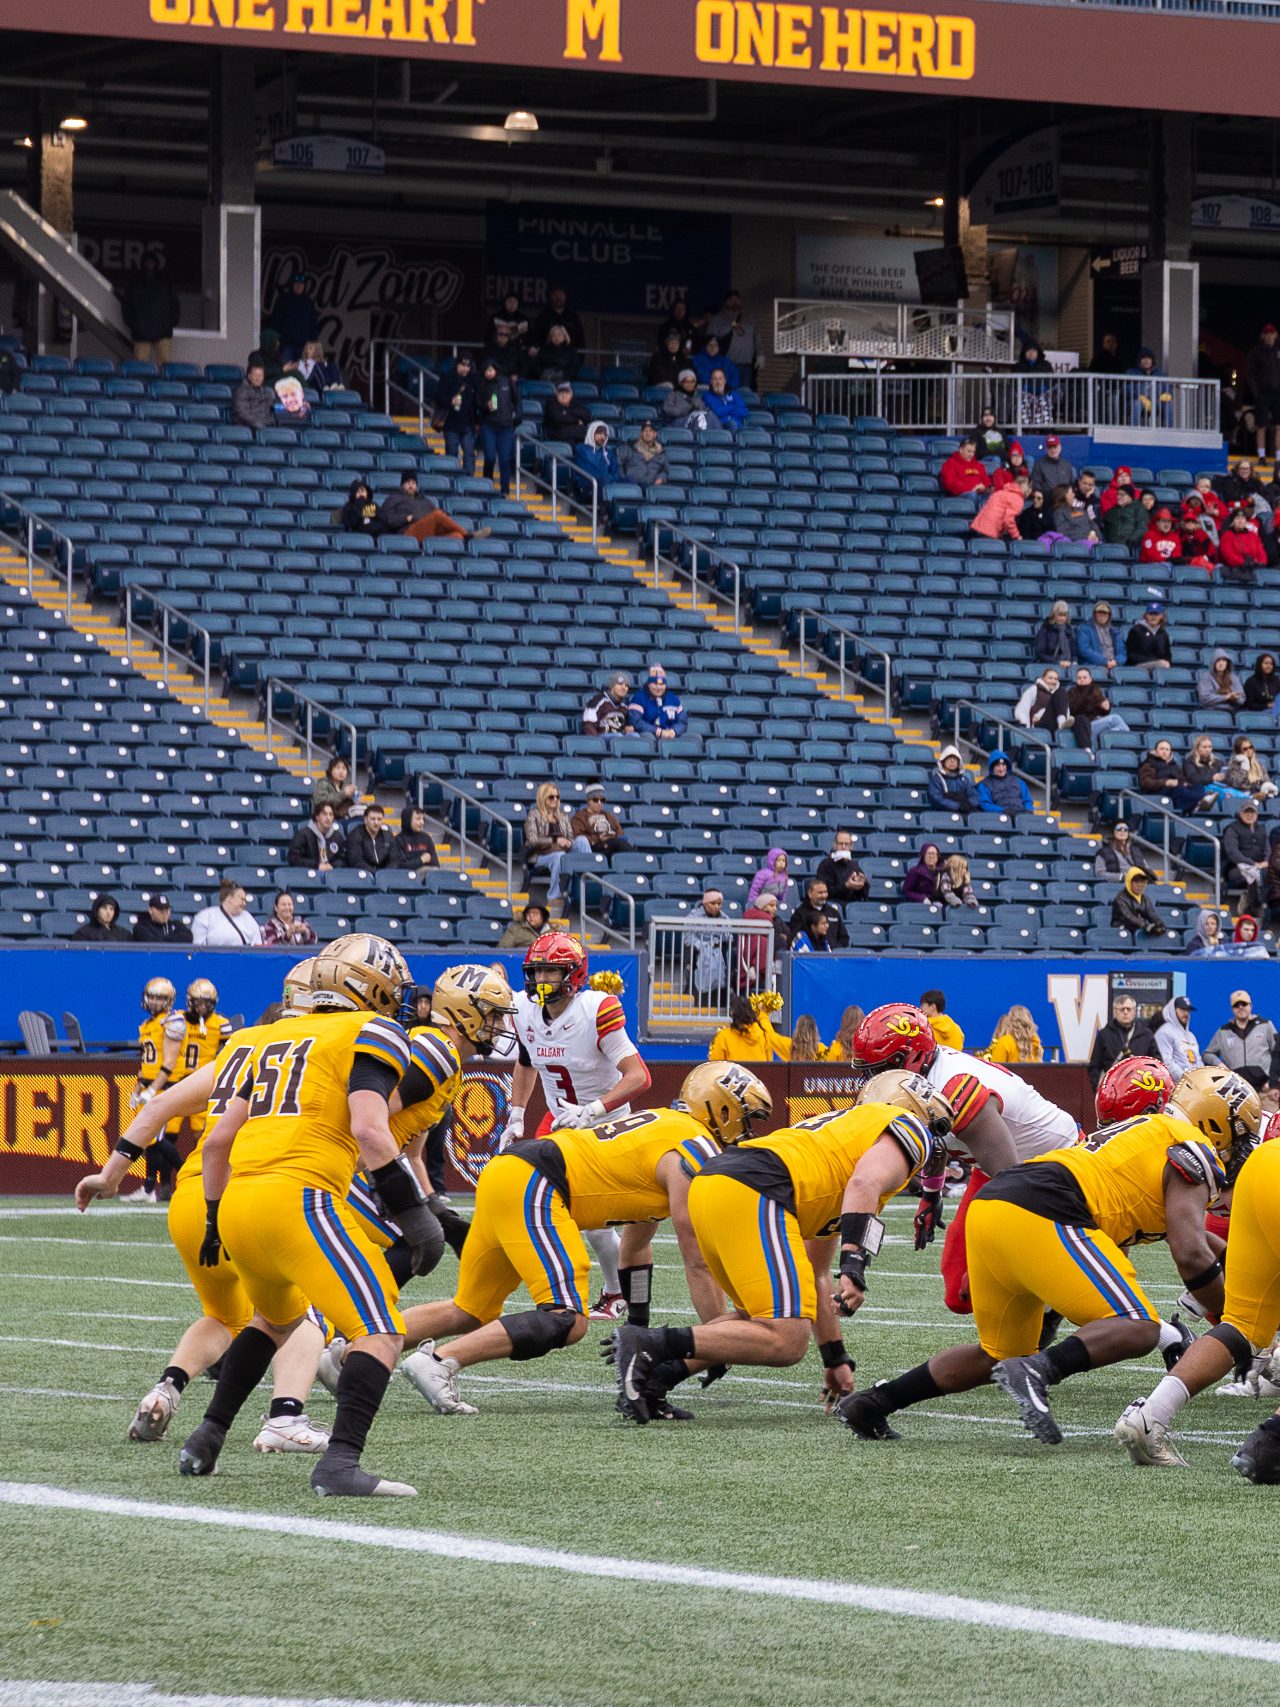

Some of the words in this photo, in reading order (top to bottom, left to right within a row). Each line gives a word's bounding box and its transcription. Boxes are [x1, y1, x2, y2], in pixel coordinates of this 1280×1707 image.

[563, 0, 623, 62] M
[696, 0, 812, 69] ONE
[820, 7, 976, 80] HERD
[289, 143, 313, 161] 106
[346, 147, 369, 165] 107
[998, 161, 1053, 198] 107-108
[1201, 203, 1221, 220] 107
[1250, 206, 1271, 223] 108
[518, 217, 663, 241] PINNACLE
[550, 242, 633, 264] CLUB
[1112, 246, 1140, 262] LIQUOR
[809, 263, 828, 274] THE
[832, 264, 879, 276] OFFICIAL
[881, 267, 906, 278] BEER
[1120, 261, 1140, 275] BEER
[485, 274, 547, 303] ENTER
[812, 276, 827, 286] OF
[830, 277, 848, 288] THE
[851, 278, 903, 290] WINNIPEG
[820, 288, 843, 299] BLUE
[847, 289, 897, 301] BOMBERS
[645, 284, 688, 310] EXIT
[456, 966, 488, 993] M
[536, 1047, 565, 1058] CALGARY
[248, 1037, 317, 1118] 51
[545, 1065, 579, 1108] 3
[717, 1065, 753, 1100] M
[902, 1075, 936, 1102] M
[1216, 1075, 1250, 1113] M
